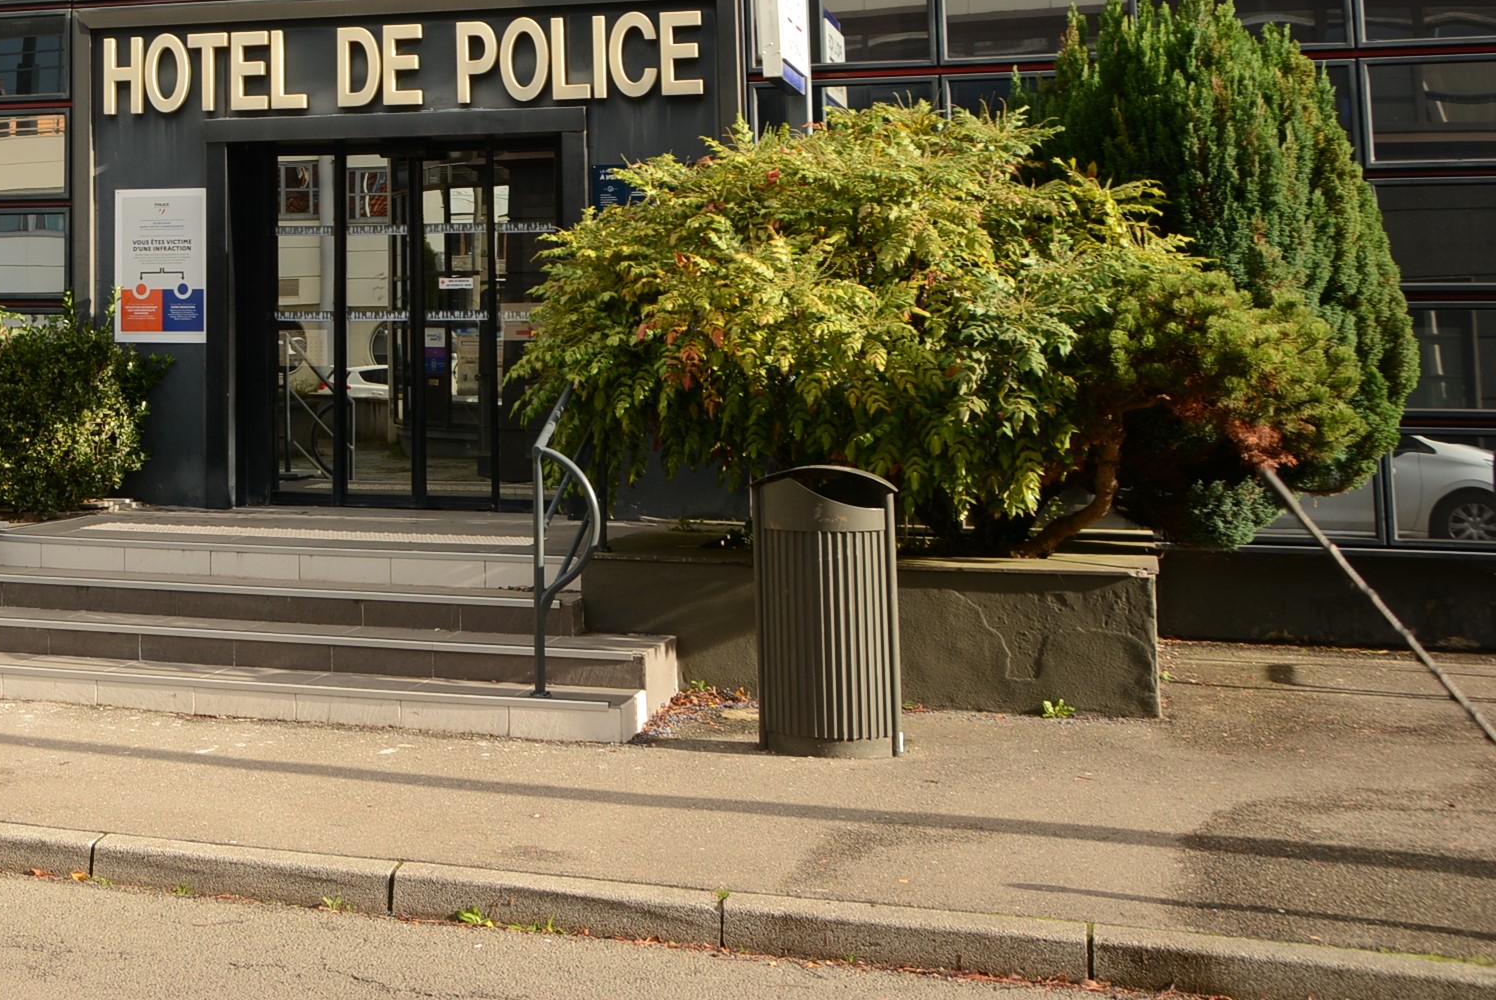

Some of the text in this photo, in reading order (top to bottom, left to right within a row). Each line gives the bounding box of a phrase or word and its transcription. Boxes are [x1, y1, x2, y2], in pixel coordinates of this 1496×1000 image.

[103, 29, 308, 115] HOTEL
[336, 23, 424, 108] DE
[455, 10, 704, 104] POLICE
